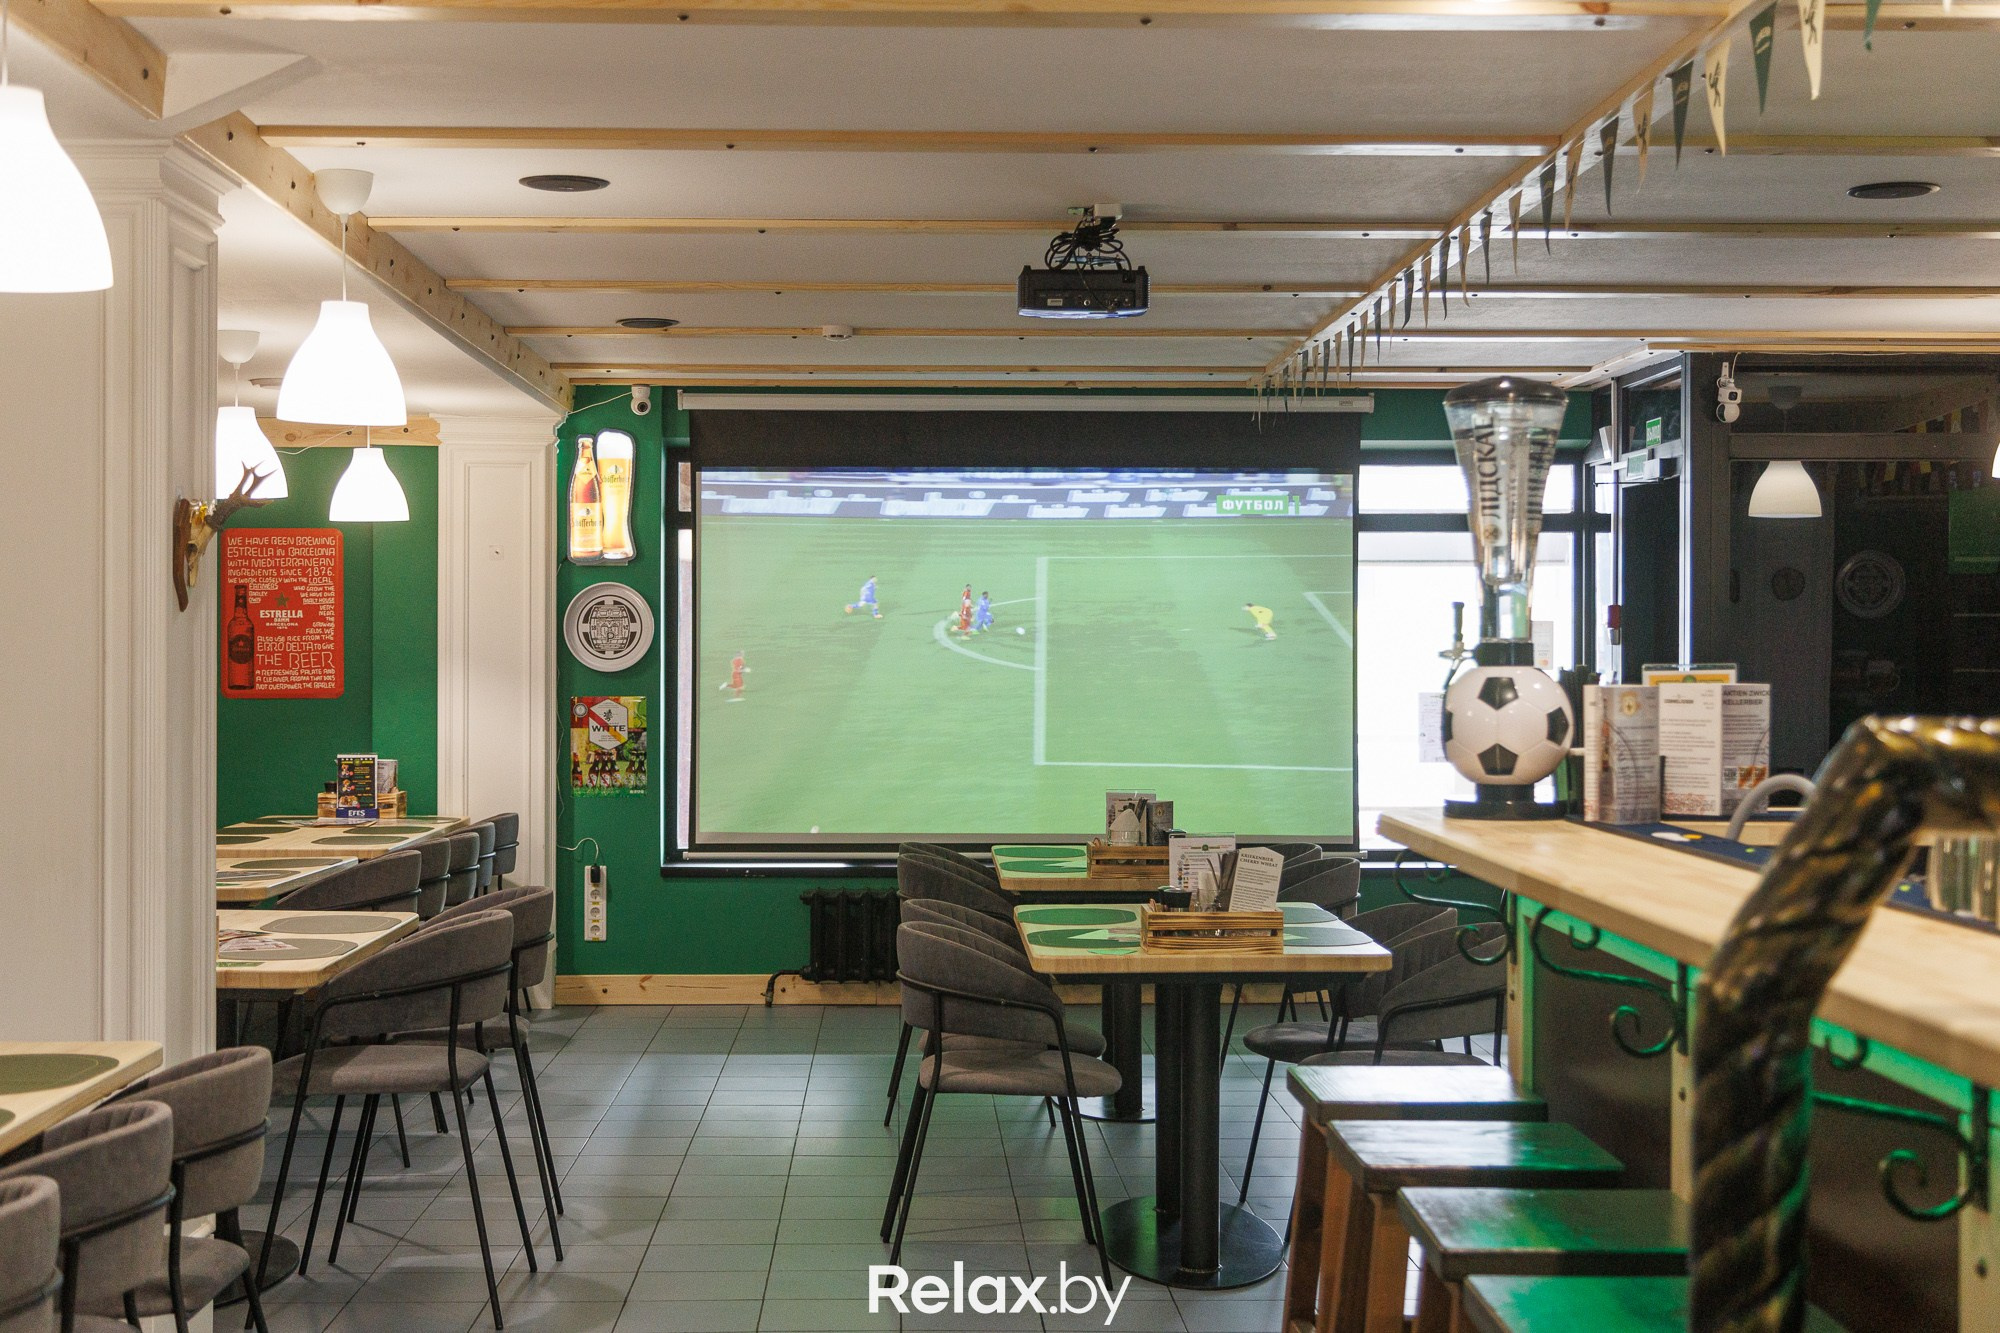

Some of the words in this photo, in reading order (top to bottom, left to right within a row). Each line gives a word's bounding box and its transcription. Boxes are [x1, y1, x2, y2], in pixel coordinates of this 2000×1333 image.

[1222, 499, 1284, 511] ФУТБОЛ
[1292, 495, 1300, 515] 1
[227, 537, 242, 545] WE
[245, 537, 269, 545] HAVE
[271, 537, 294, 545] BEEN
[296, 536, 335, 545] BREWING
[227, 547, 274, 557] ESTRELLA
[288, 548, 335, 556] BARCELONA
[252, 558, 334, 567] MEDITERRANEAN
[227, 568, 277, 576] INGREDIENTS
[306, 567, 335, 577] 1876.
[260, 610, 303, 618] ESTRELLA
[257, 642, 284, 651] EBRO
[286, 642, 313, 652] DELTA
[322, 642, 334, 650] GIVE
[256, 654, 282, 665] THE
[289, 652, 335, 669] BEER
[592, 725, 626, 733] WITTE
